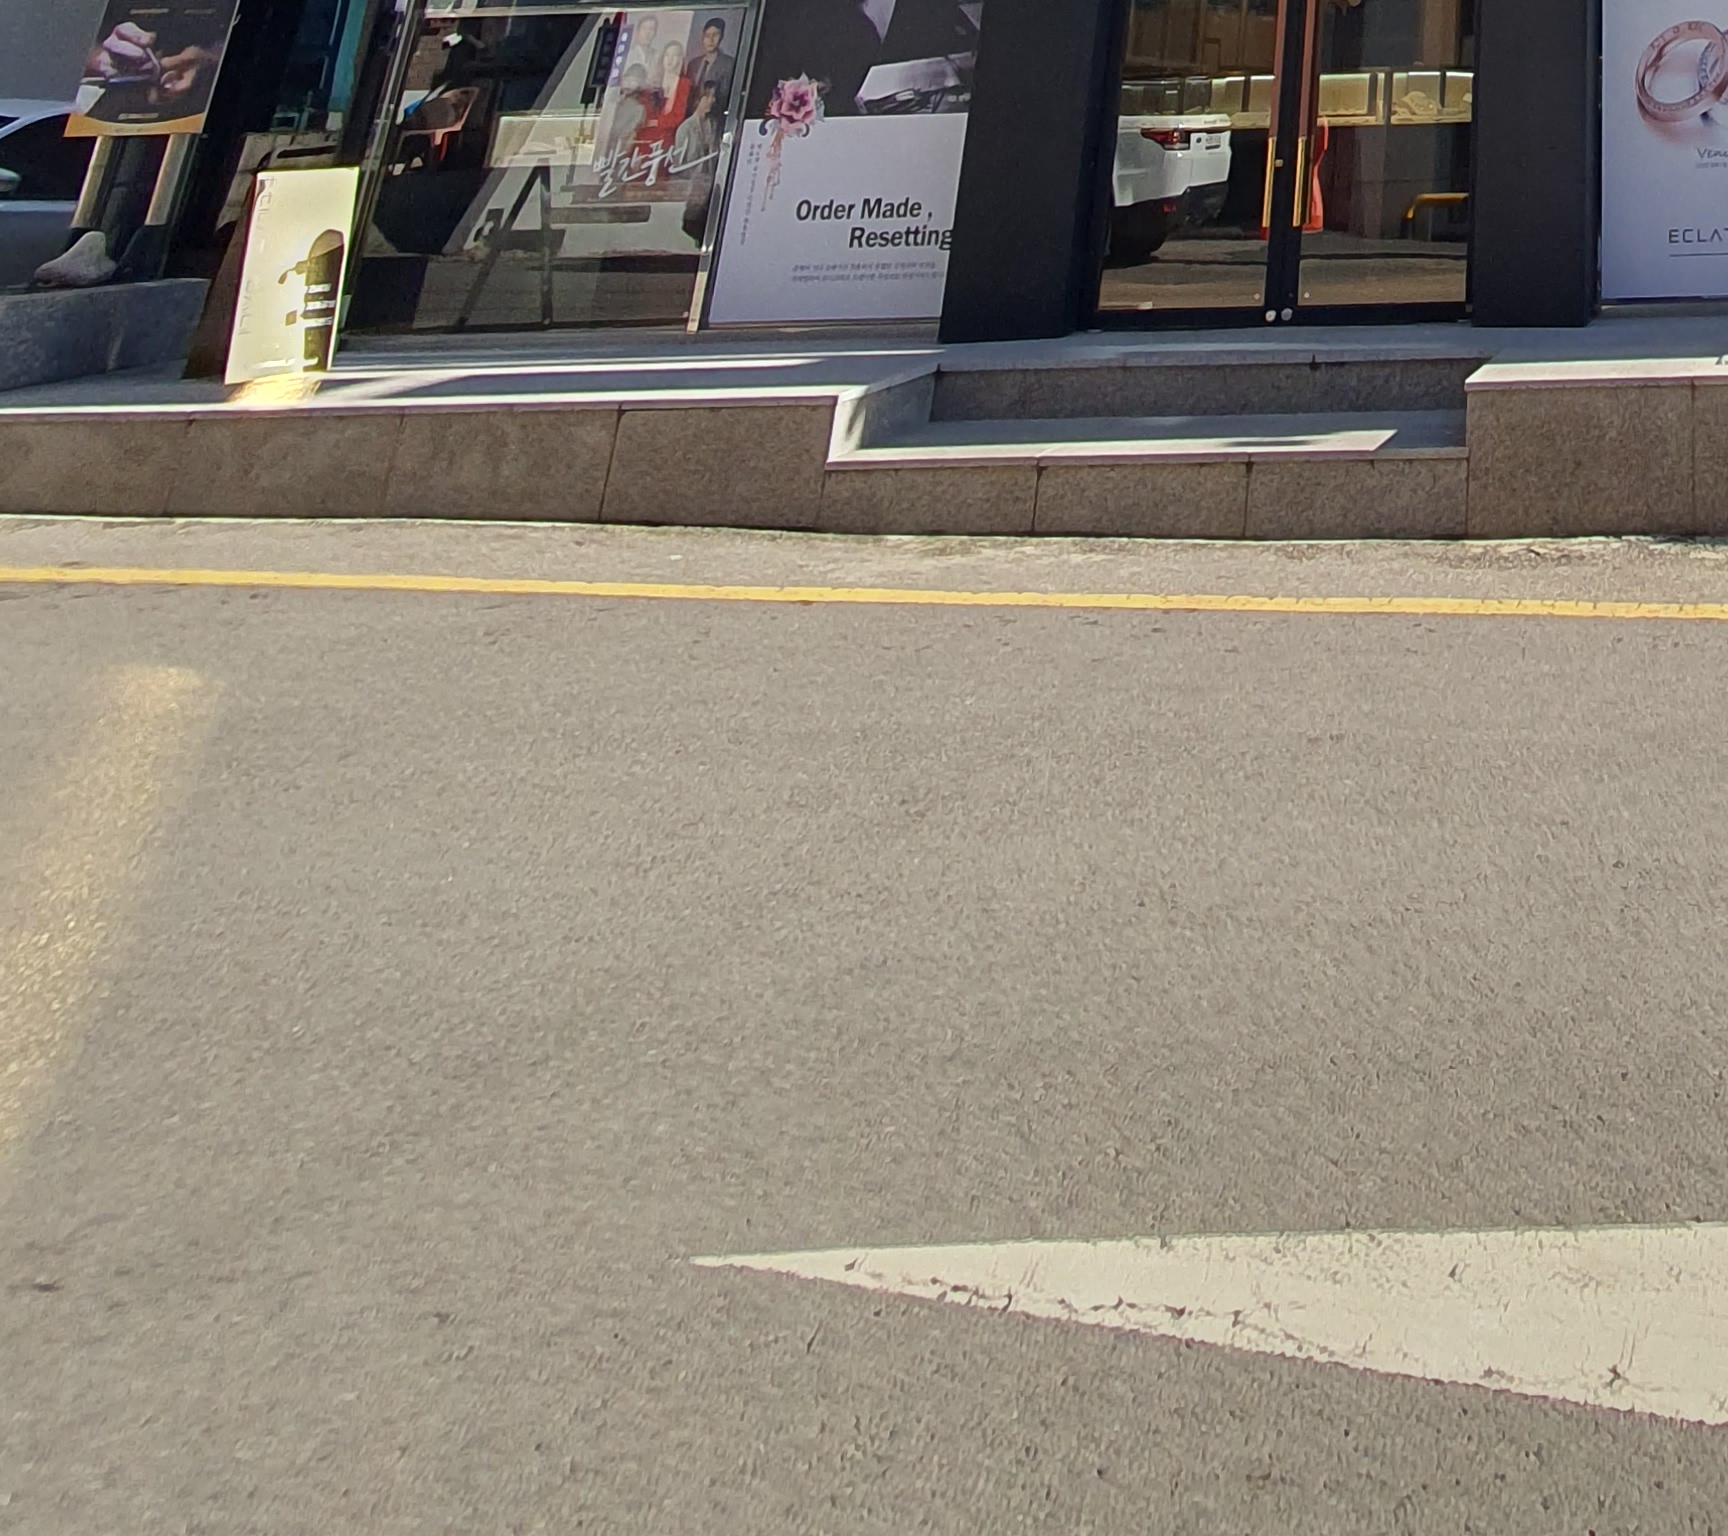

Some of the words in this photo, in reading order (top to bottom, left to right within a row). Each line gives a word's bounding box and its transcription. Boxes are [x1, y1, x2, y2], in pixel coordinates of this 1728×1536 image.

[592, 138, 719, 199] 빨간풍선
[796, 198, 855, 222] Order
[849, 225, 952, 251] Resetting
